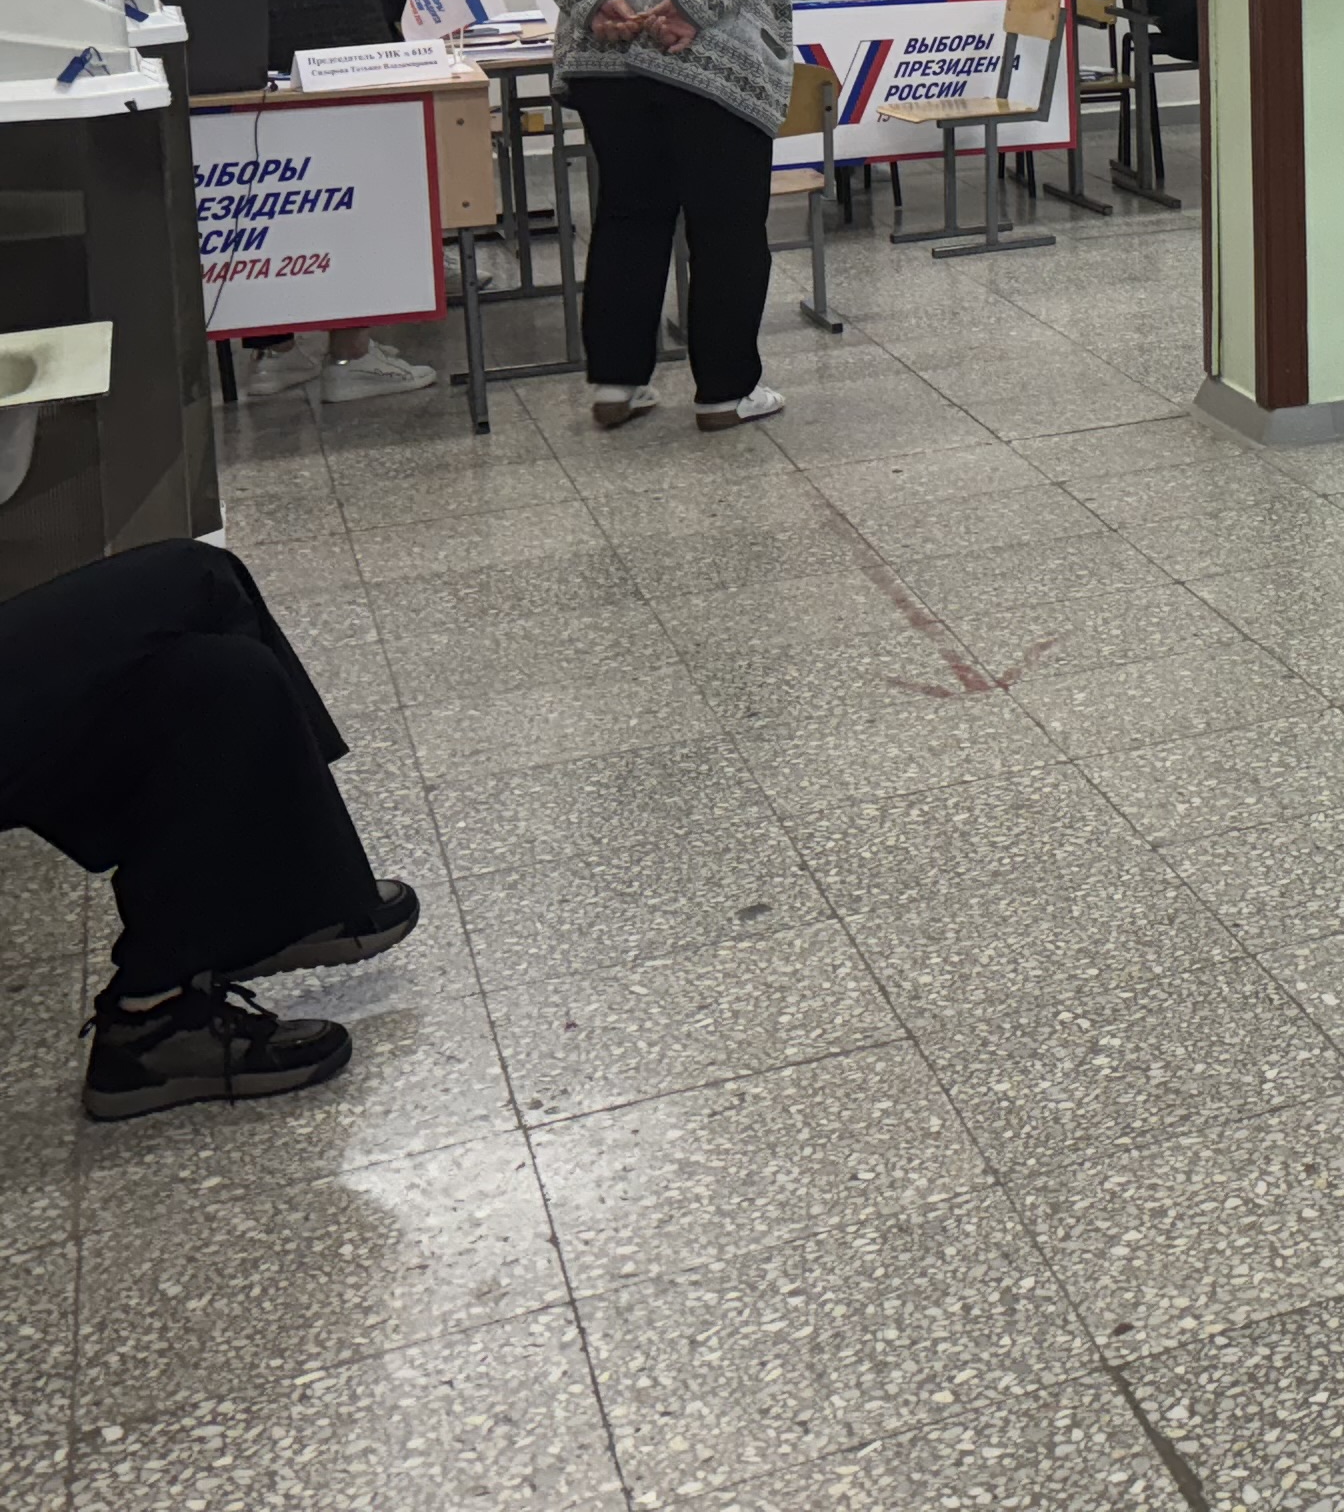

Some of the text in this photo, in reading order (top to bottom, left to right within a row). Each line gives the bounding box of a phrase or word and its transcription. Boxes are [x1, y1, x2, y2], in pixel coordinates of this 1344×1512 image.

[377, 50, 401, 60] УИК
[412, 47, 433, 56] 6135
[904, 33, 994, 56] ВЫБОРЫ
[894, 55, 1021, 79] ПРЕЗИДЕНА
[883, 80, 968, 103] РОССИИ
[193, 157, 312, 188] ЫБОРЫ
[197, 186, 355, 221] ЕЗИДЕНТА
[199, 226, 270, 255] СИИ
[275, 253, 331, 277] 2024
